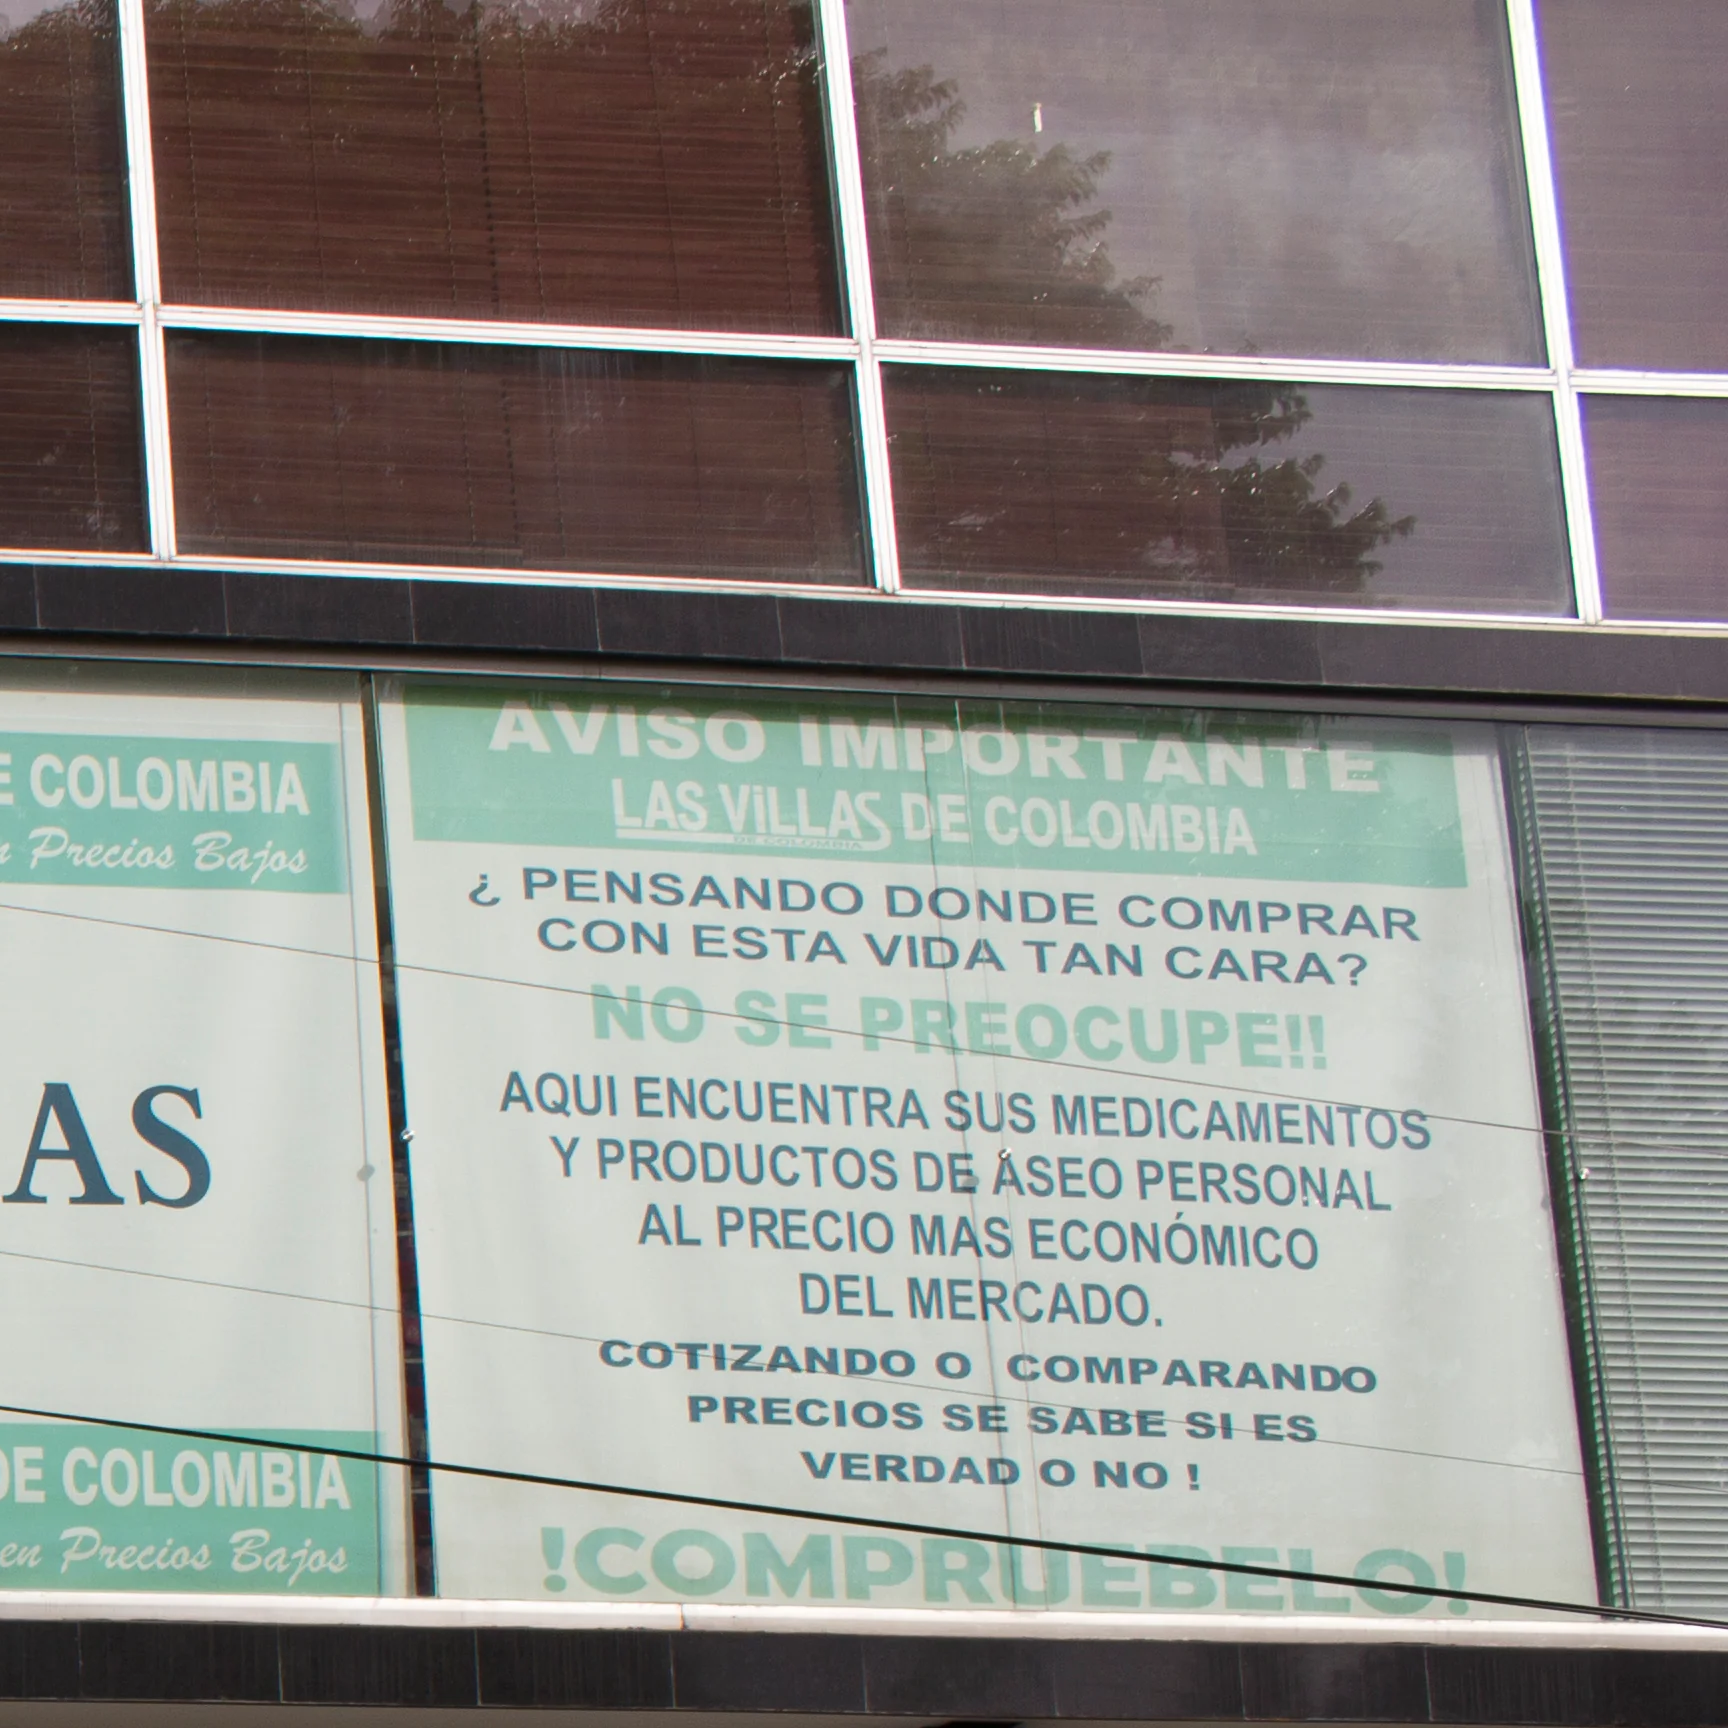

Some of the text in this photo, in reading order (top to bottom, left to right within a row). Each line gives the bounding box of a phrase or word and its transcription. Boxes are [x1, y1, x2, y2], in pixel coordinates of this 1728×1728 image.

[488, 702, 1381, 795] AVISO IMPORTANTE
[29, 753, 310, 818] COLOMBIA
[611, 778, 708, 835] LAS
[902, 791, 970, 846] DE
[984, 794, 1259, 858] COLOMBIA
[27, 826, 176, 872] Precios
[192, 833, 310, 879] Bajos
[522, 865, 864, 919] PENSANDO
[884, 886, 1101, 929] DONDE
[1117, 893, 1422, 943] COMPRAR
[536, 915, 1370, 990] CON ESTA VIDA TAN CARA?
[590, 982, 1329, 1072] NO SE PREOCUPE!!
[499, 1068, 1433, 1152] AQUI ENCUENTRA SUS MEDICAMENTOS
[549, 1135, 1394, 1214] Y PRODUCTOS DE ASEO PERSONAL
[637, 1200, 1321, 1271] AL PRECIO MAS ECONÓMICO
[797, 1269, 1165, 1328] DEL MERCADO.
[598, 1338, 1381, 1394] COTIZANDO O COMPARANDO
[686, 1394, 1320, 1445] PRECIOS SE SABE SI ES
[61, 1447, 352, 1513] COLOMBIA
[799, 1449, 1023, 1488] VERDAD
[1038, 1457, 1078, 1490] O
[1091, 1460, 1172, 1493] NO
[57, 1528, 211, 1576] Precios
[228, 1531, 350, 1584] Bajos
